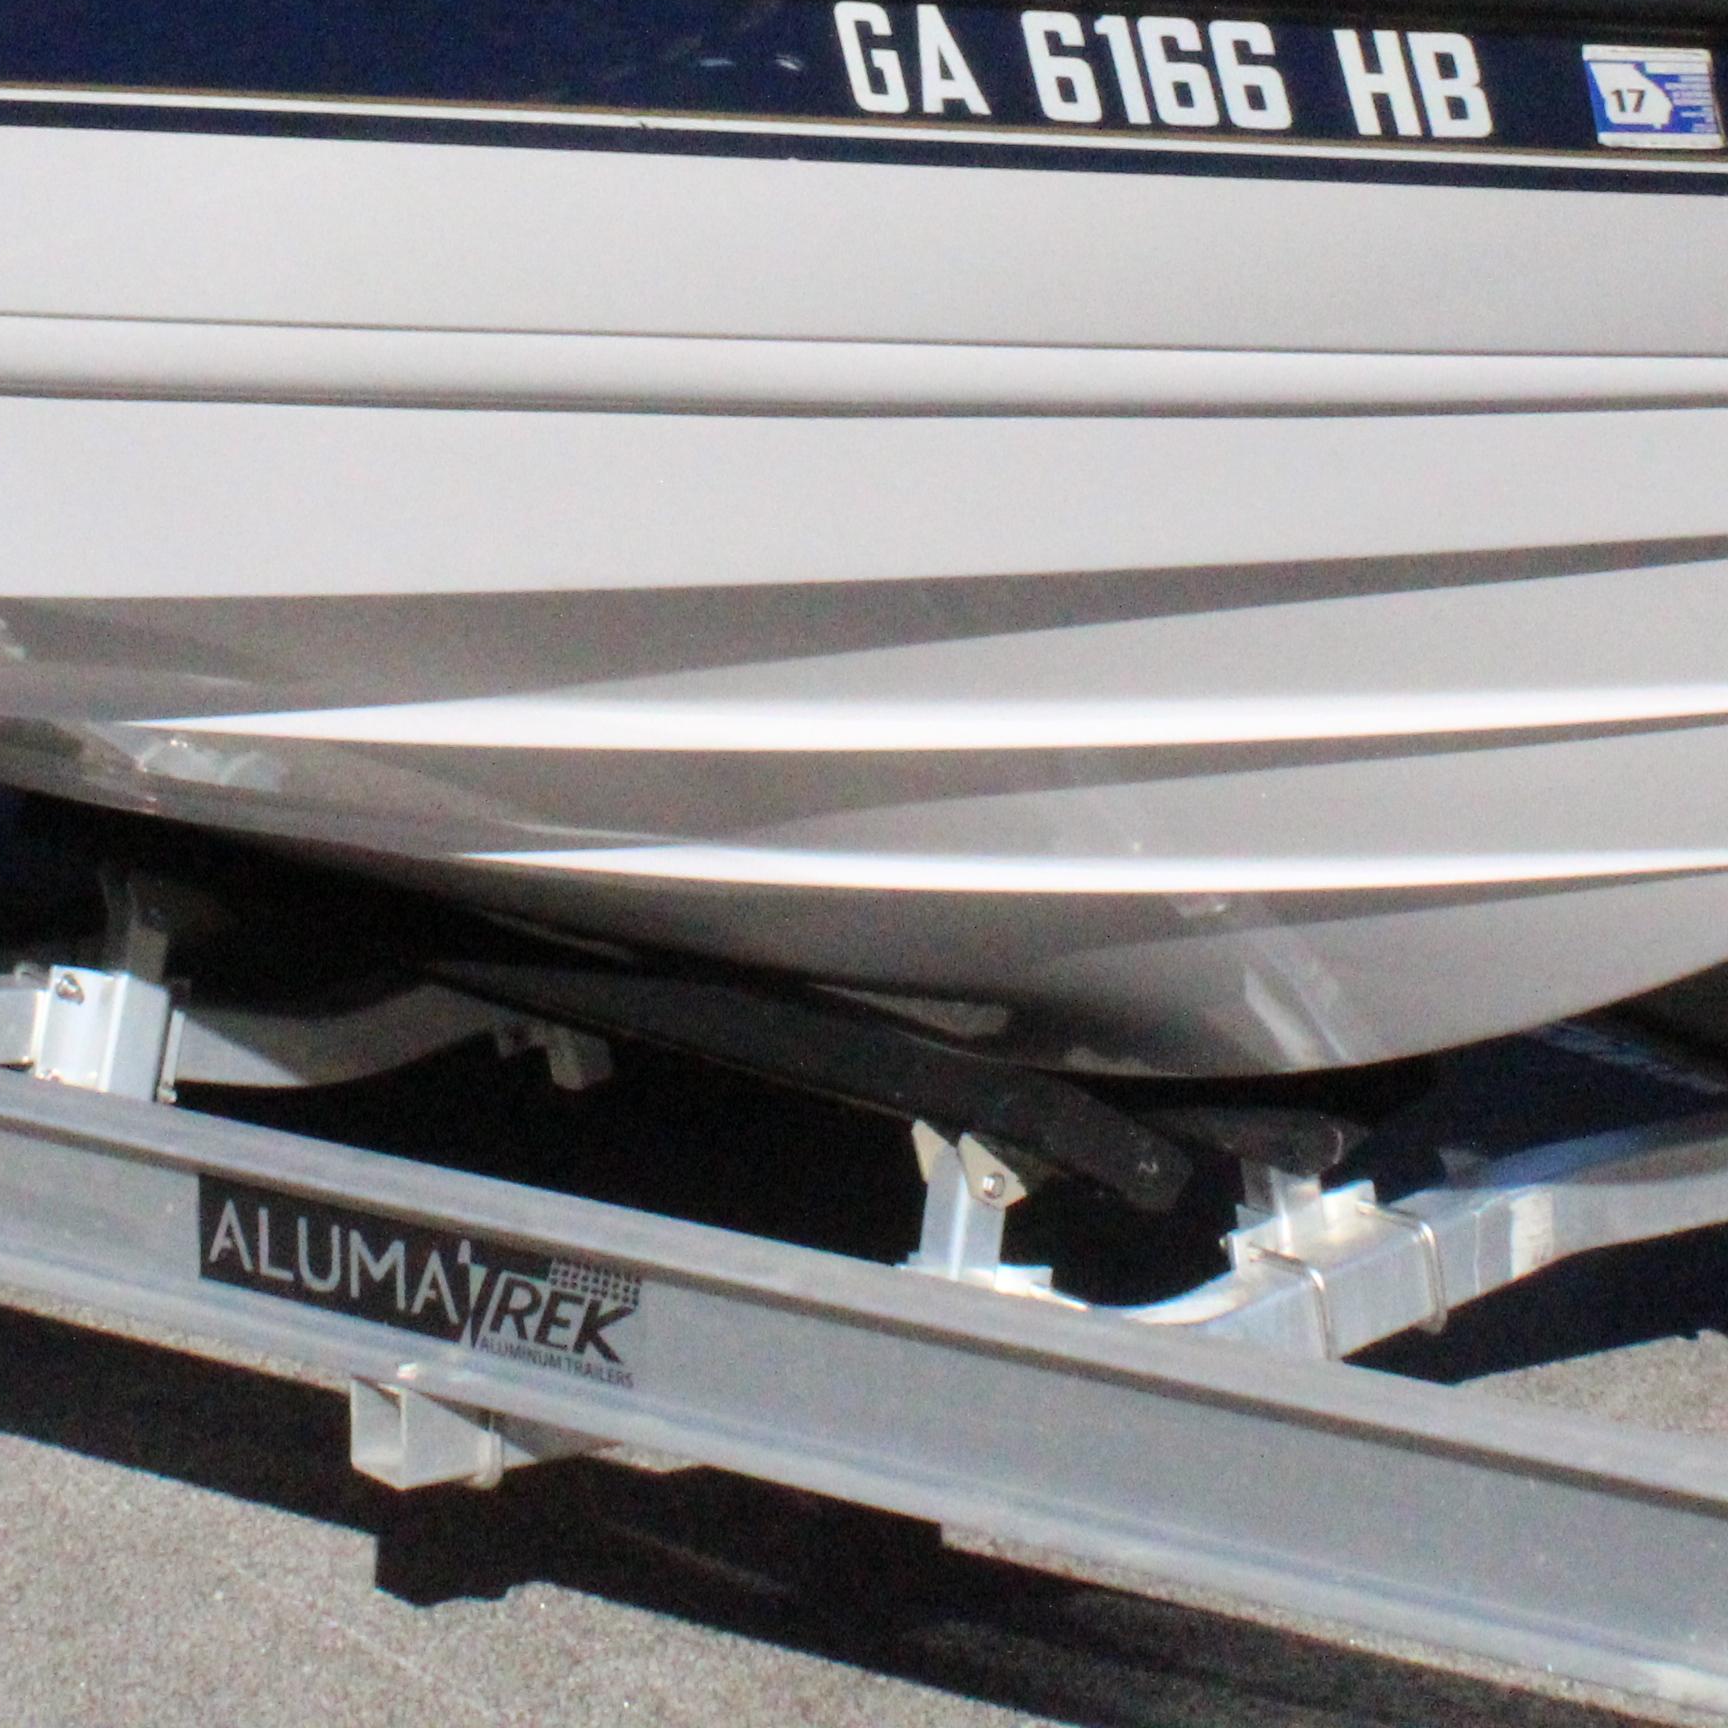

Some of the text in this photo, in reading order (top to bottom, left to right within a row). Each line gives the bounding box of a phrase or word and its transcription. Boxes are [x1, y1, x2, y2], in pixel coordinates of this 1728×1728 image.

[834, 1, 1492, 138] GA 6166 HB
[1611, 87, 1646, 113] 17
